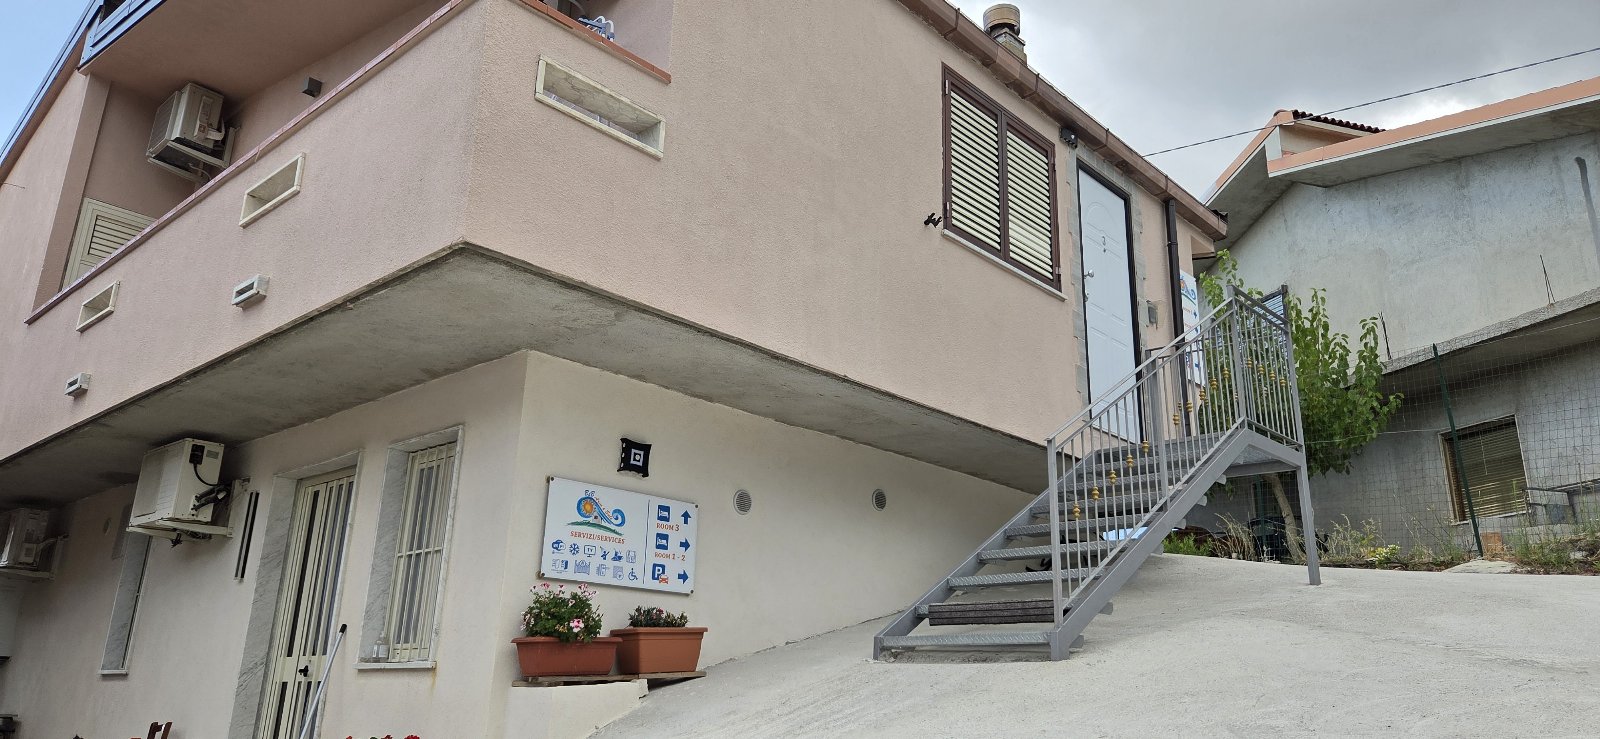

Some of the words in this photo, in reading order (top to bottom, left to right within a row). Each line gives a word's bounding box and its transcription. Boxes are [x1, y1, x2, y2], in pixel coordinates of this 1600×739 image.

[656, 522, 674, 531] ROOM
[675, 524, 680, 532] 3
[570, 530, 626, 545] SERVIZI/SERVICES
[654, 551, 671, 560] ROOM
